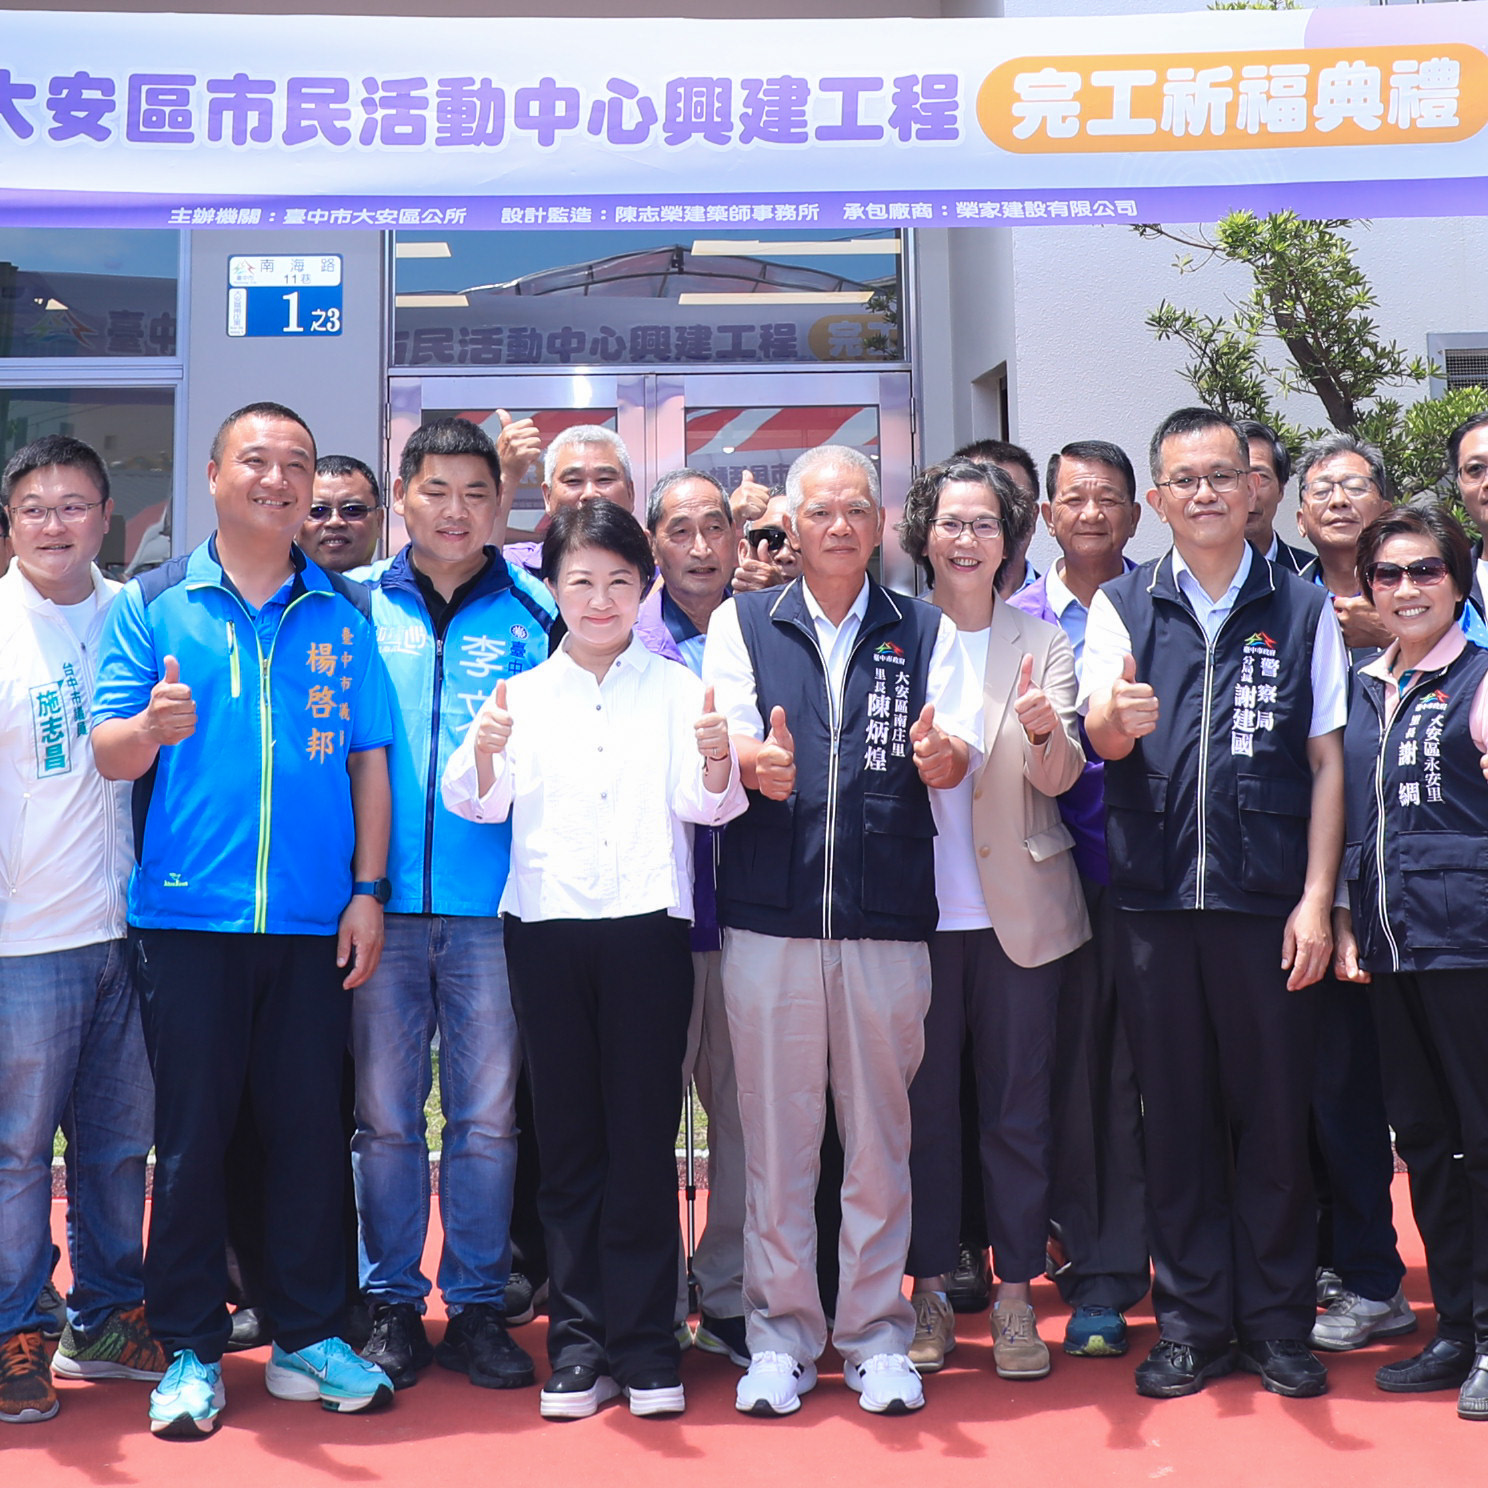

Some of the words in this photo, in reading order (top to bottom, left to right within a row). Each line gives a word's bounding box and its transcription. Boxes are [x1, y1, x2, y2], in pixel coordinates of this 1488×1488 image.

[1012, 56, 1461, 141] 完工祈福典禮
[874, 667, 887, 694] 里長
[890, 670, 911, 758] 大安區南庄里
[1231, 682, 1258, 758] 謝建國
[1255, 656, 1281, 732] 警察局
[35, 689, 66, 772] 施志昌
[864, 692, 892, 772] 陳炳煌
[1422, 713, 1447, 805] 大安區永安里
